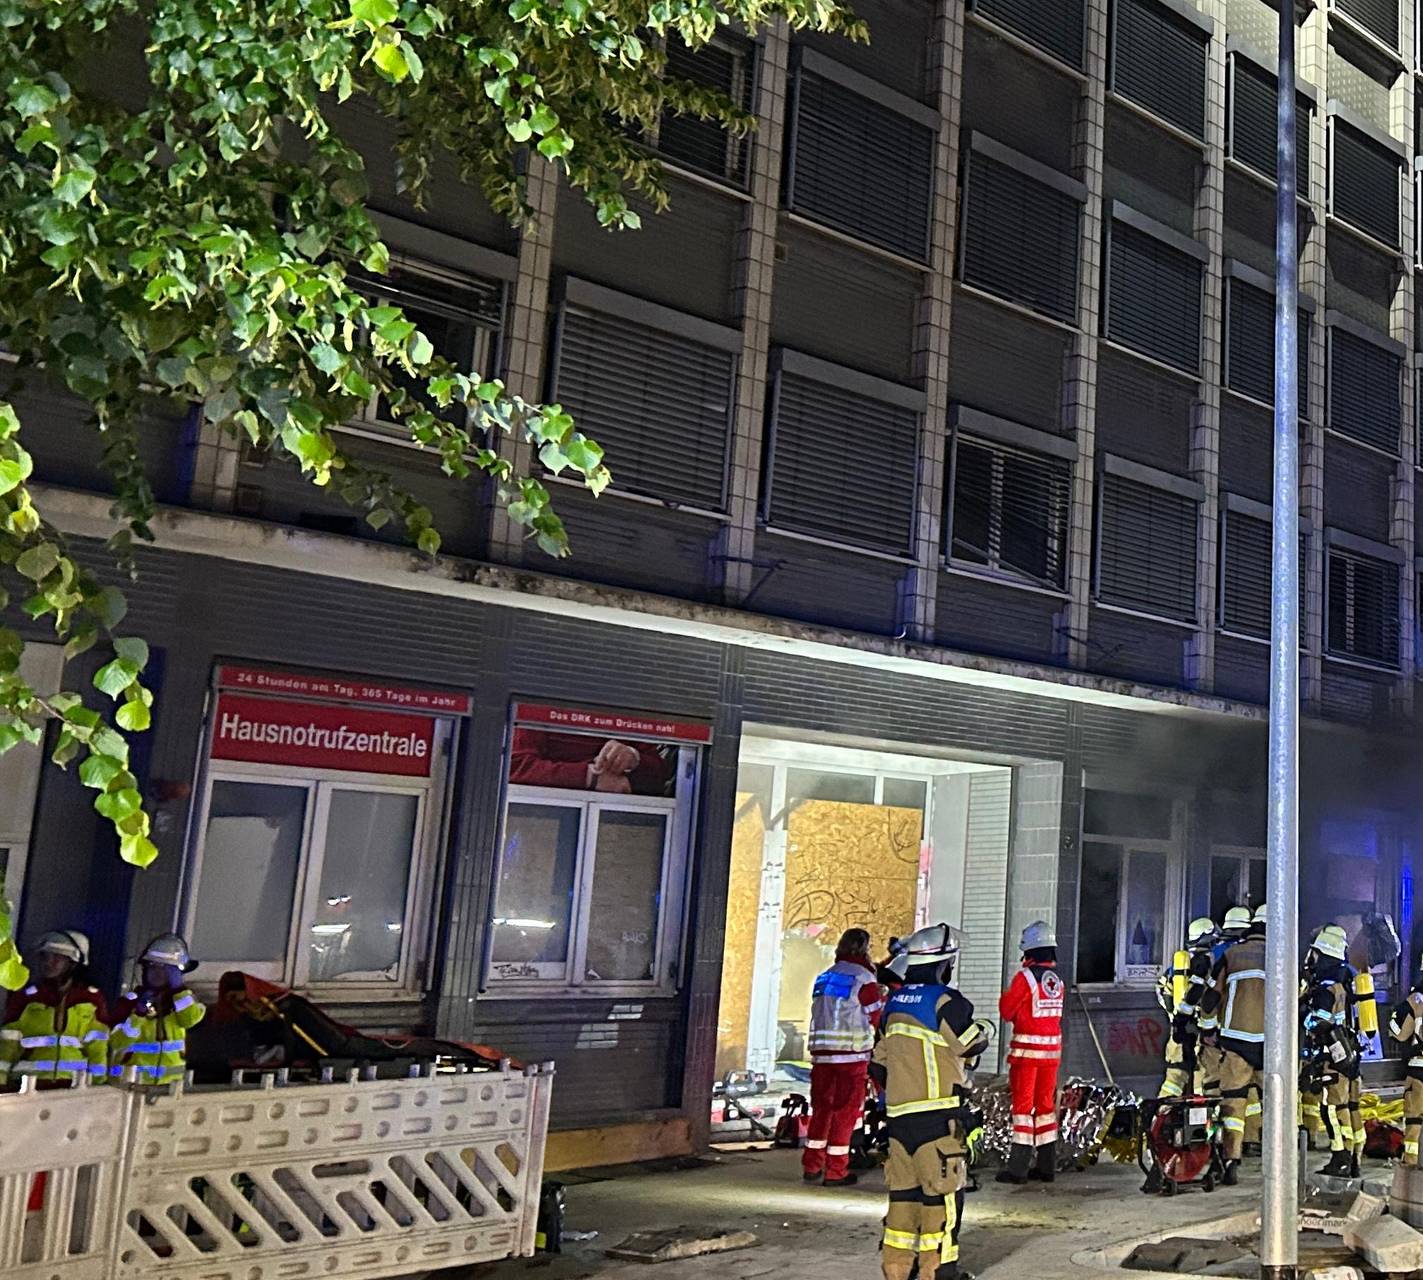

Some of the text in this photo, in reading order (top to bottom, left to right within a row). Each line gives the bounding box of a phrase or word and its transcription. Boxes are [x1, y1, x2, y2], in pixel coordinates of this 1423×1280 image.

[237, 673, 253, 683] 24
[256, 674, 308, 690] Stunden
[311, 683, 330, 693] am
[361, 687, 382, 698] 365
[386, 690, 412, 703] Tage
[415, 692, 429, 703] im
[431, 696, 456, 706] Jahr
[219, 712, 428, 758] Hausnotrufzentrale
[549, 710, 568, 720] Das
[570, 713, 591, 723] DRK
[593, 717, 613, 726] zum
[615, 718, 653, 730] Drücken
